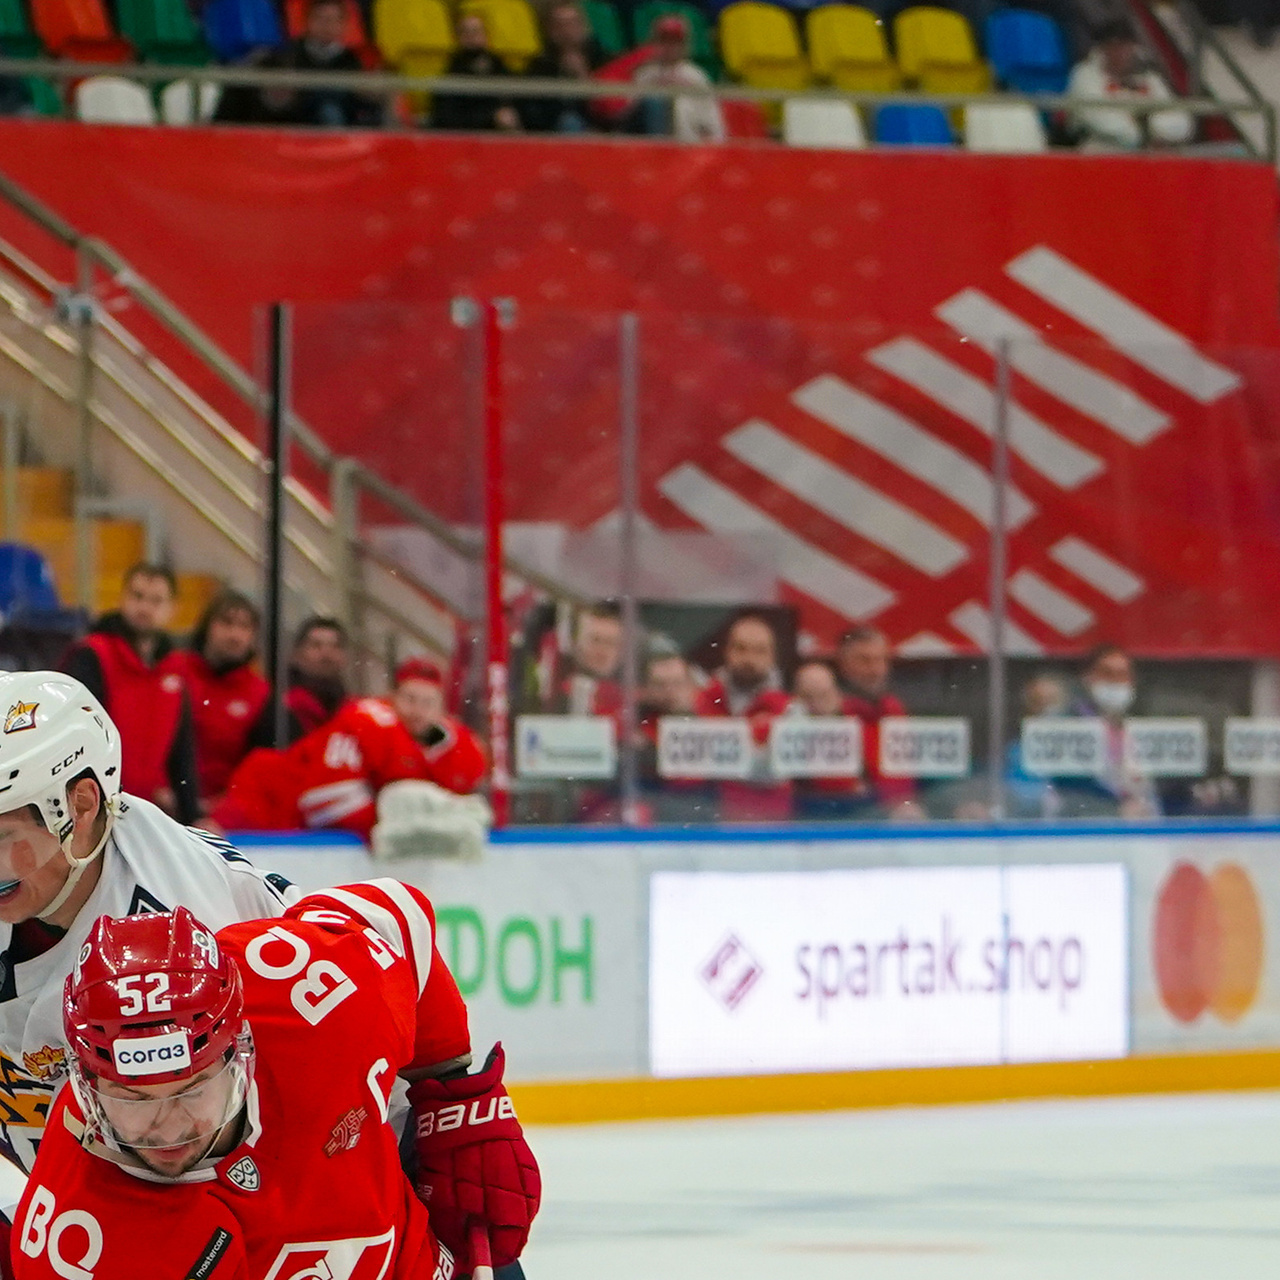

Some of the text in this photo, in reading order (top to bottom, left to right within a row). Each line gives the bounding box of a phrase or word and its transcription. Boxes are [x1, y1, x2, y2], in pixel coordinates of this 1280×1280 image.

[50, 746, 85, 776] CCM
[245, 926, 358, 1026] BQ
[795, 912, 1084, 1019] spartak.shop
[118, 972, 172, 1017] 52
[118, 1044, 185, 1065] согаз
[195, 1230, 228, 1278] mastercard
